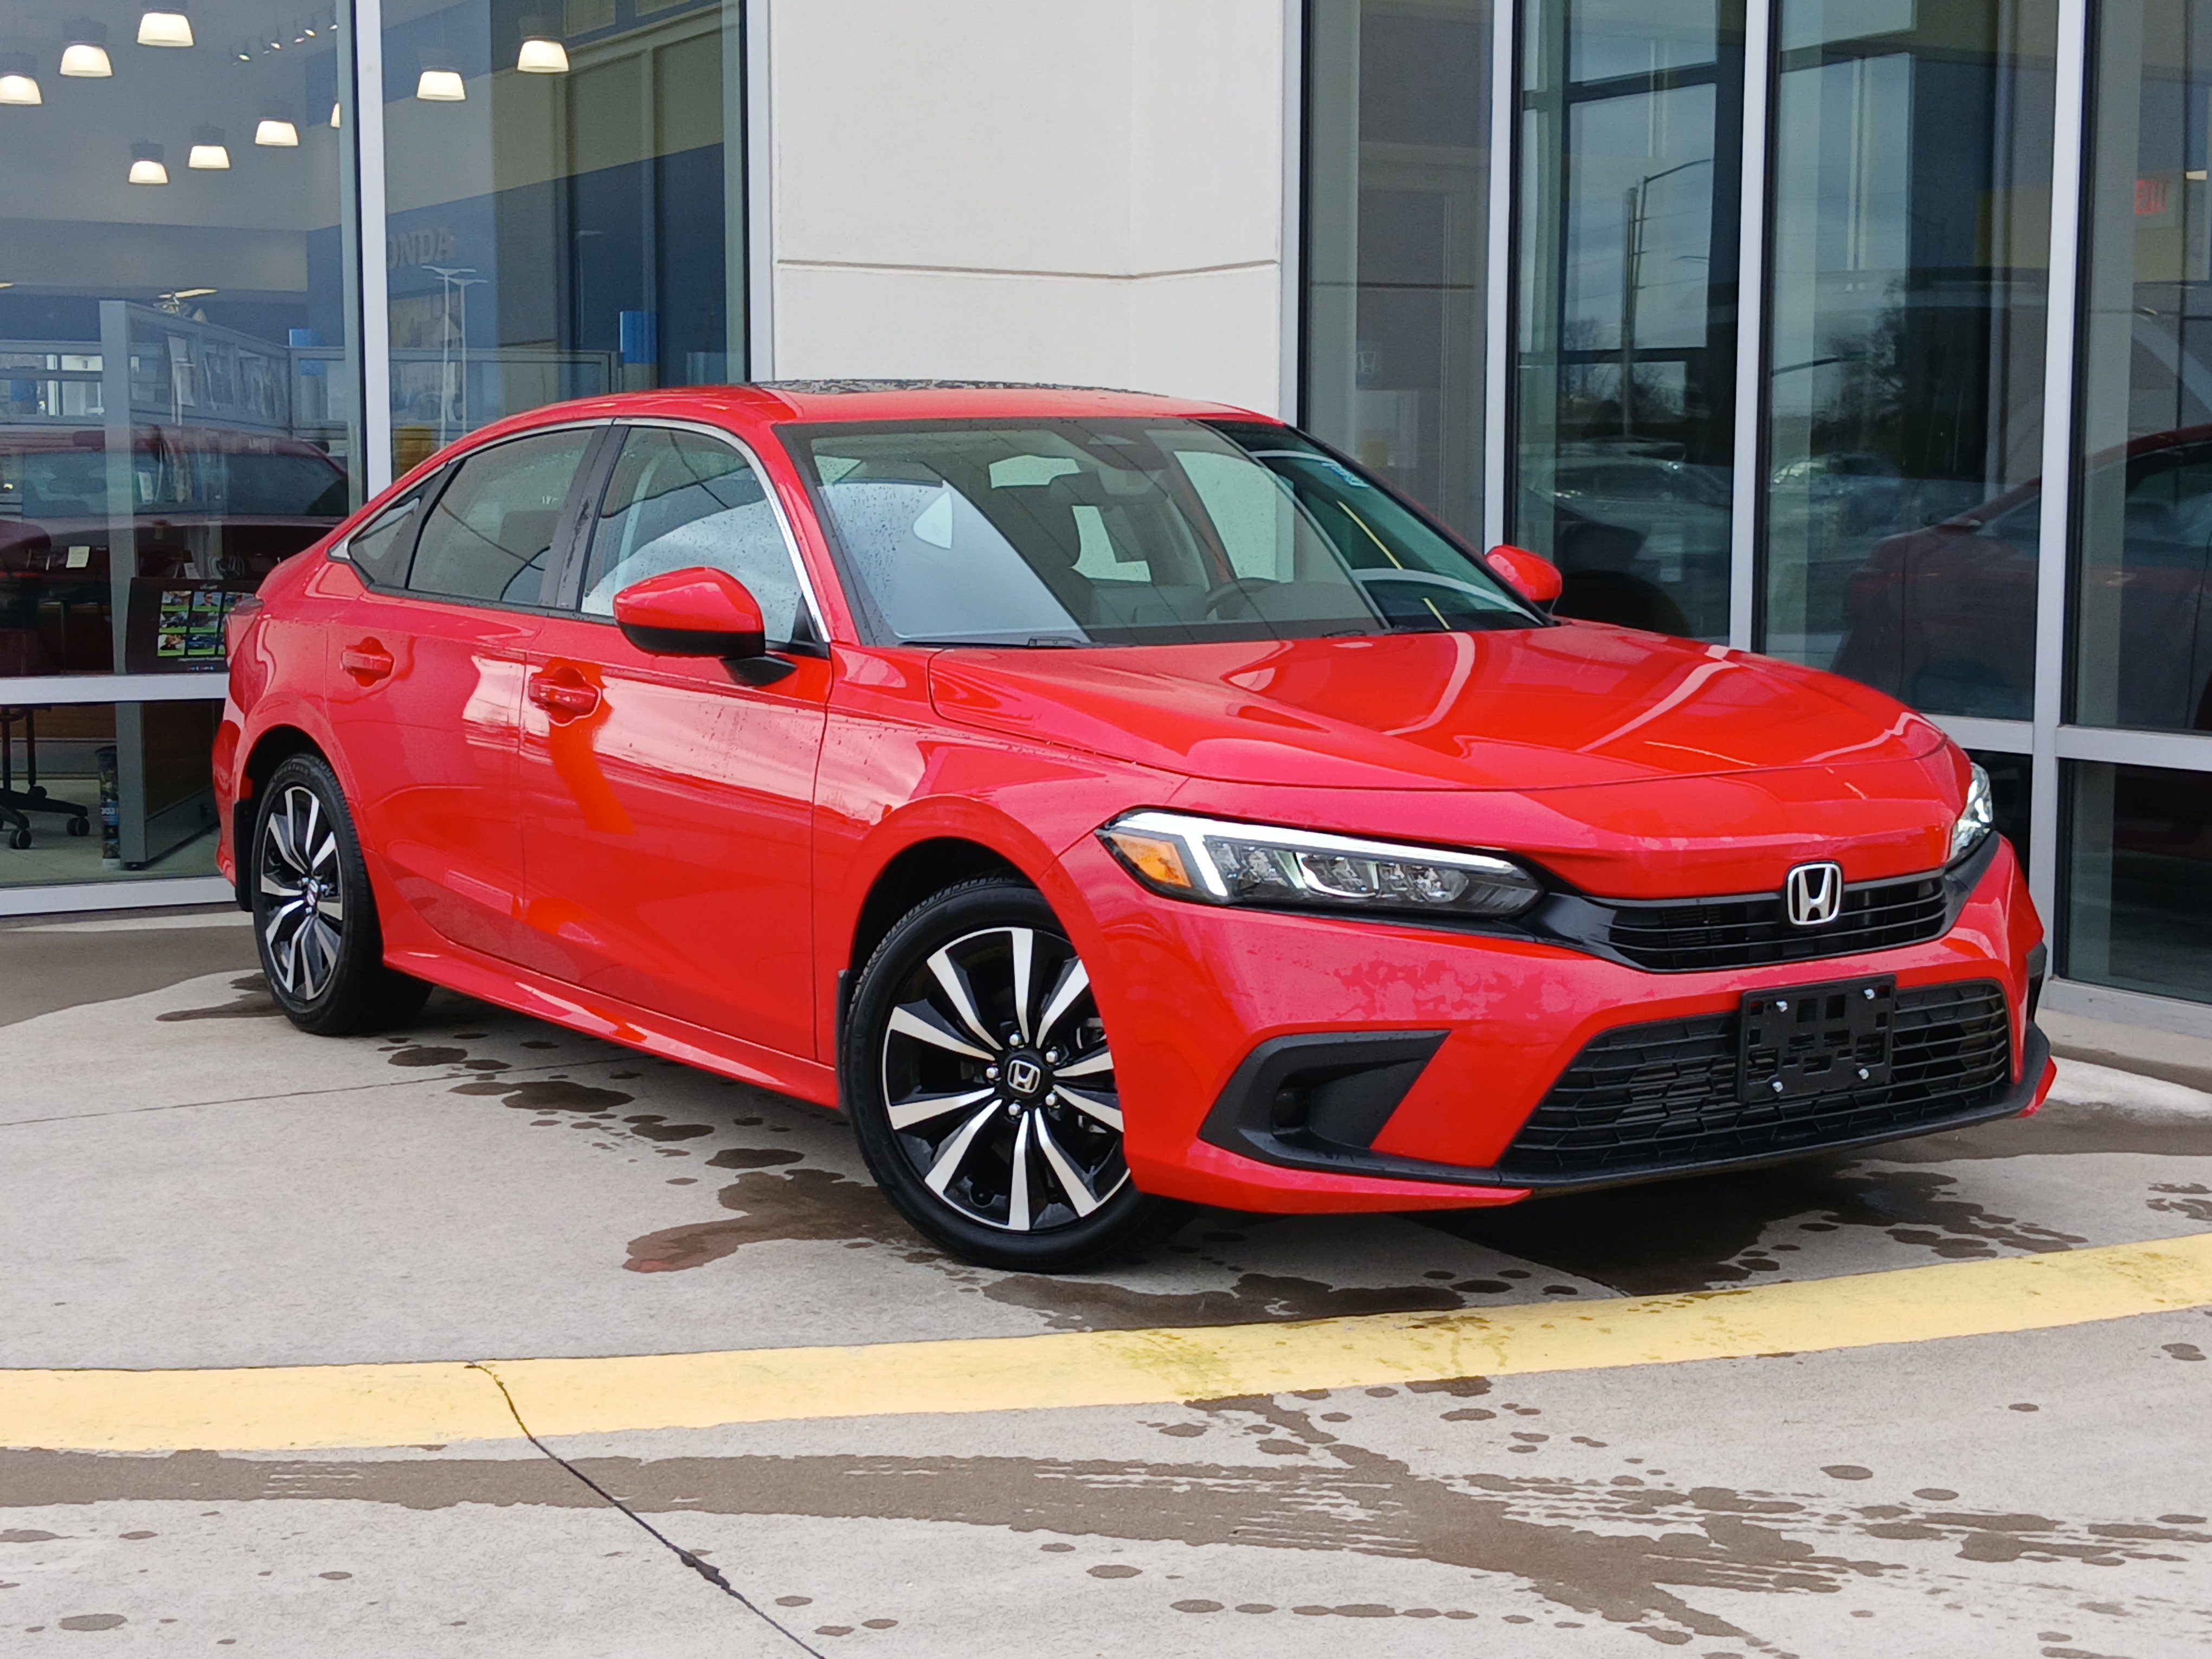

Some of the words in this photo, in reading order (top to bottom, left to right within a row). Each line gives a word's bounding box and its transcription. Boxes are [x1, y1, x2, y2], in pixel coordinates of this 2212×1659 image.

[387, 228, 456, 269] ONDA
[1795, 865, 1834, 923] H
[1011, 1062, 1037, 1091] H
